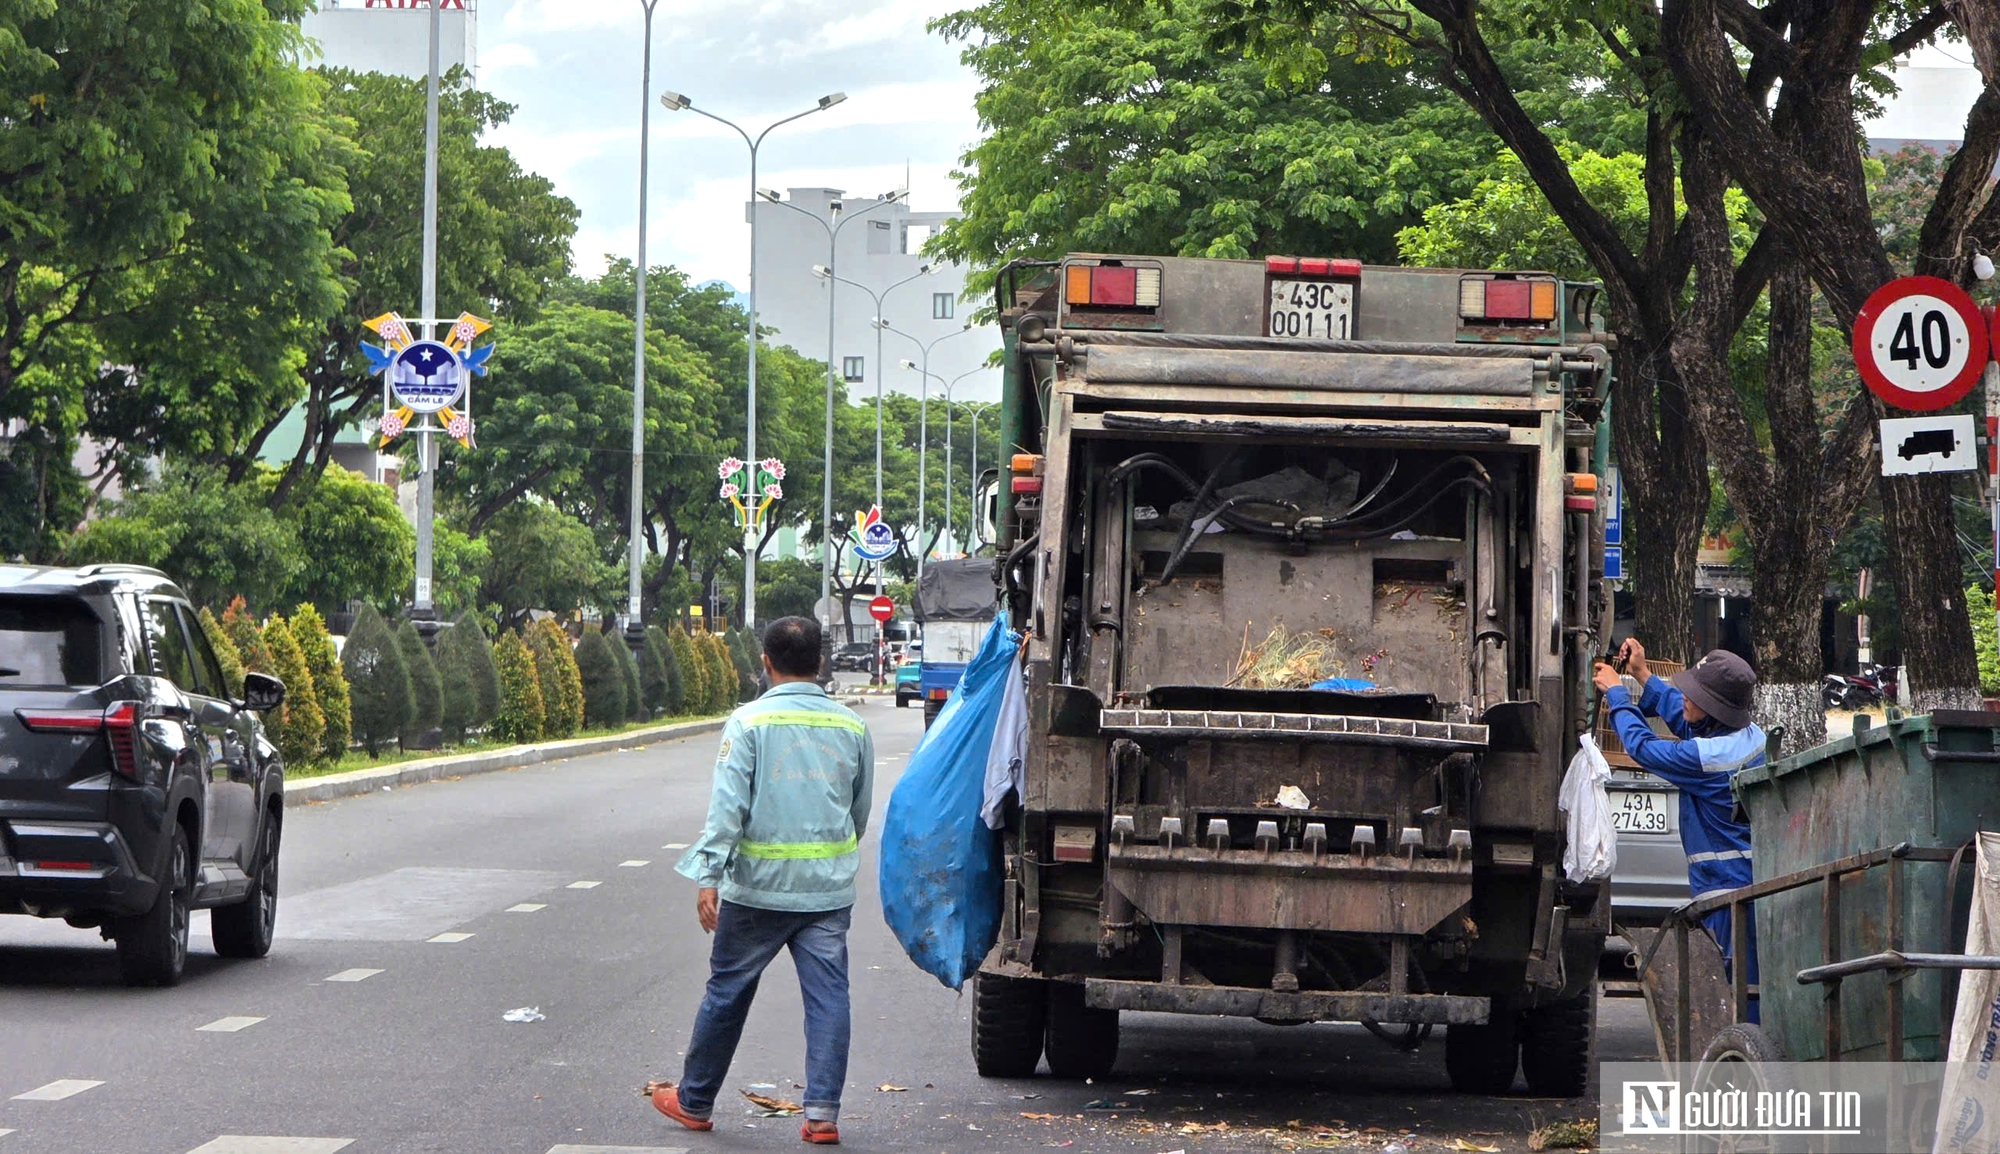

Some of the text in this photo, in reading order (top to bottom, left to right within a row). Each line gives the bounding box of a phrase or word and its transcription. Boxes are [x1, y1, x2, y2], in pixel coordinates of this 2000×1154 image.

[1290, 283, 1334, 310] 43C
[1890, 310, 1951, 370] 40
[1623, 794, 1653, 811] 43A
[1611, 812, 1666, 830] 274.39
